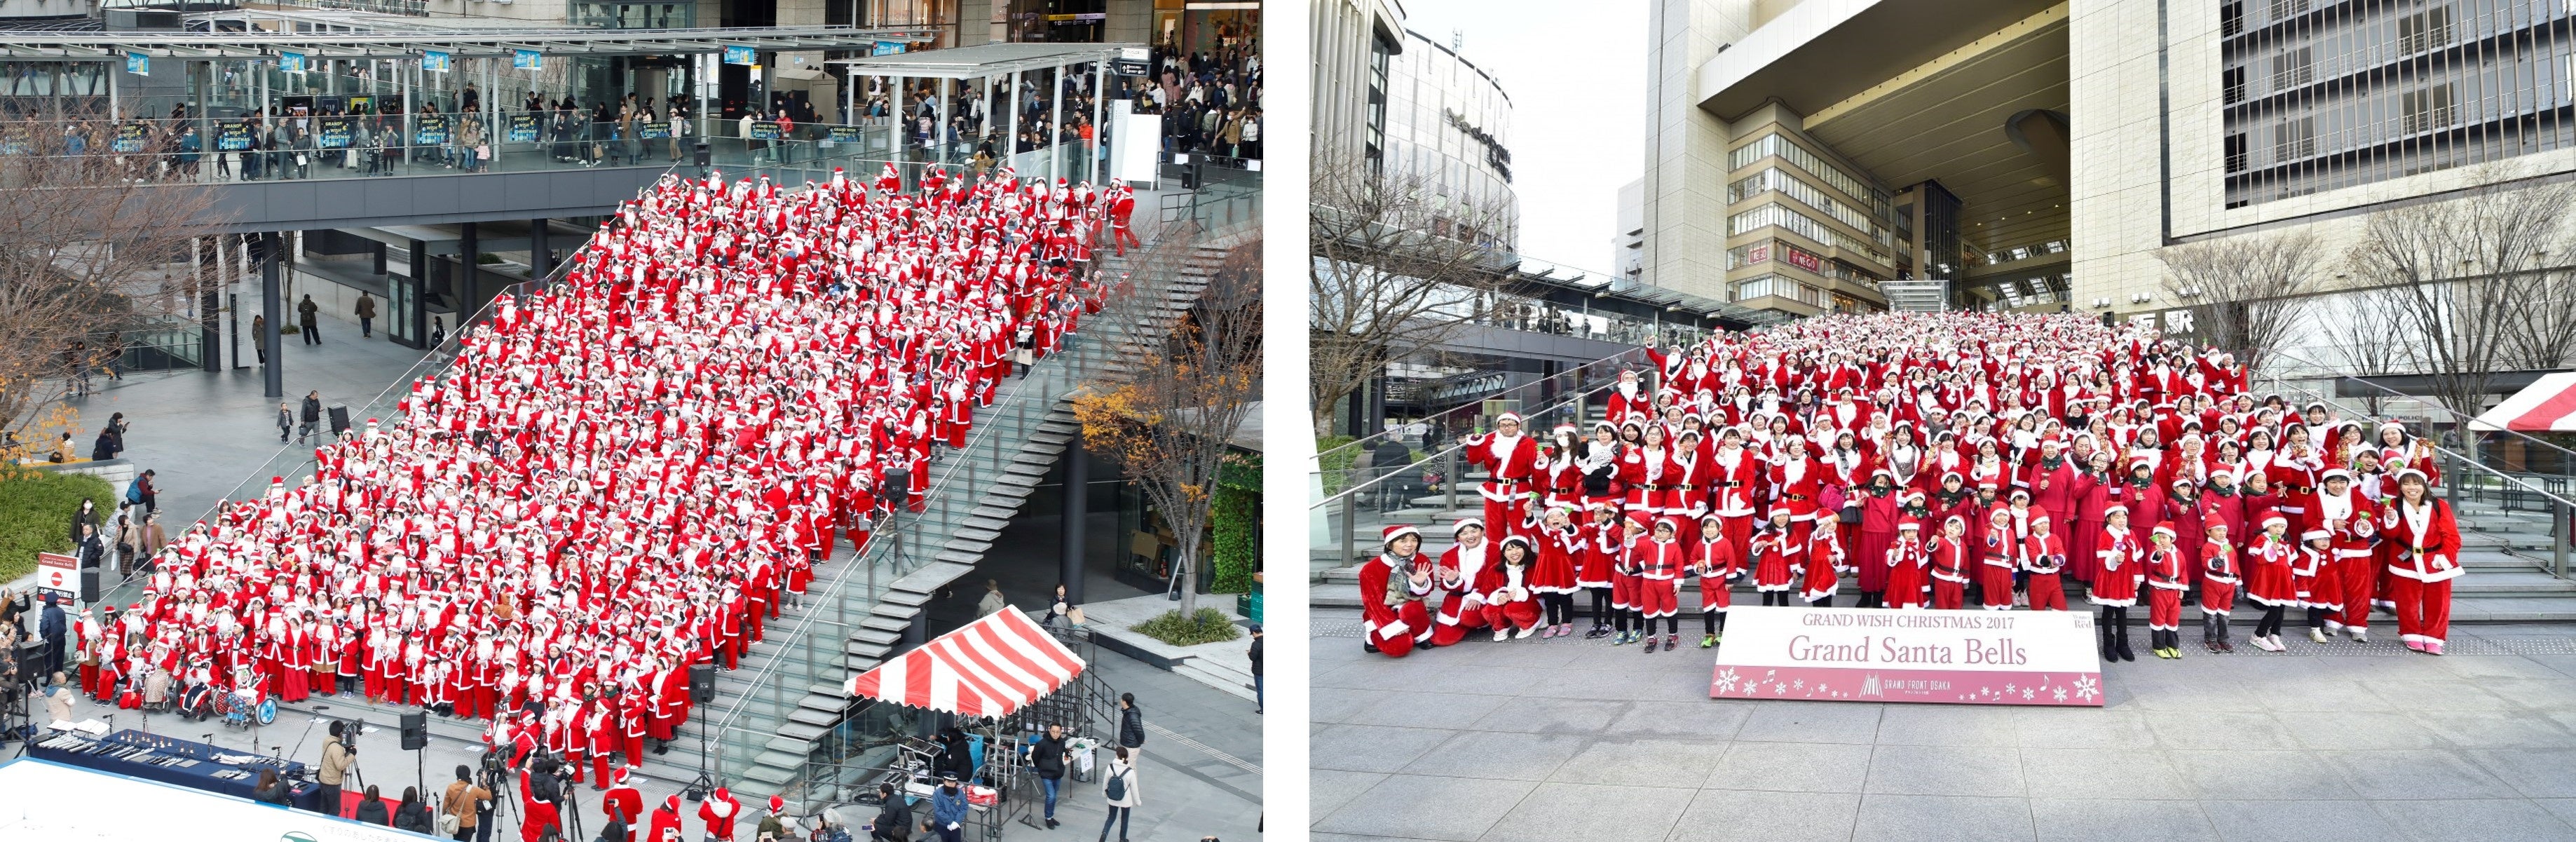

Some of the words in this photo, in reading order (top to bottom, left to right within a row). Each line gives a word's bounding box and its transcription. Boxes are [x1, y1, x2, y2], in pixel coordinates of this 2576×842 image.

[1446, 107, 1511, 165] Yodobashi
[1803, 613, 1853, 626] GRAND
[1857, 615, 1893, 627] WISH
[1897, 616, 1982, 629] CHRISTMAS
[1986, 617, 2015, 630] 2017
[1789, 634, 1870, 663] Grand
[1881, 637, 1953, 664] Santa
[1963, 637, 2027, 665] Bells
[1884, 679, 1905, 689] GRAND
[1908, 680, 1928, 690] FRONT
[1930, 680, 1951, 691] OSAKA
